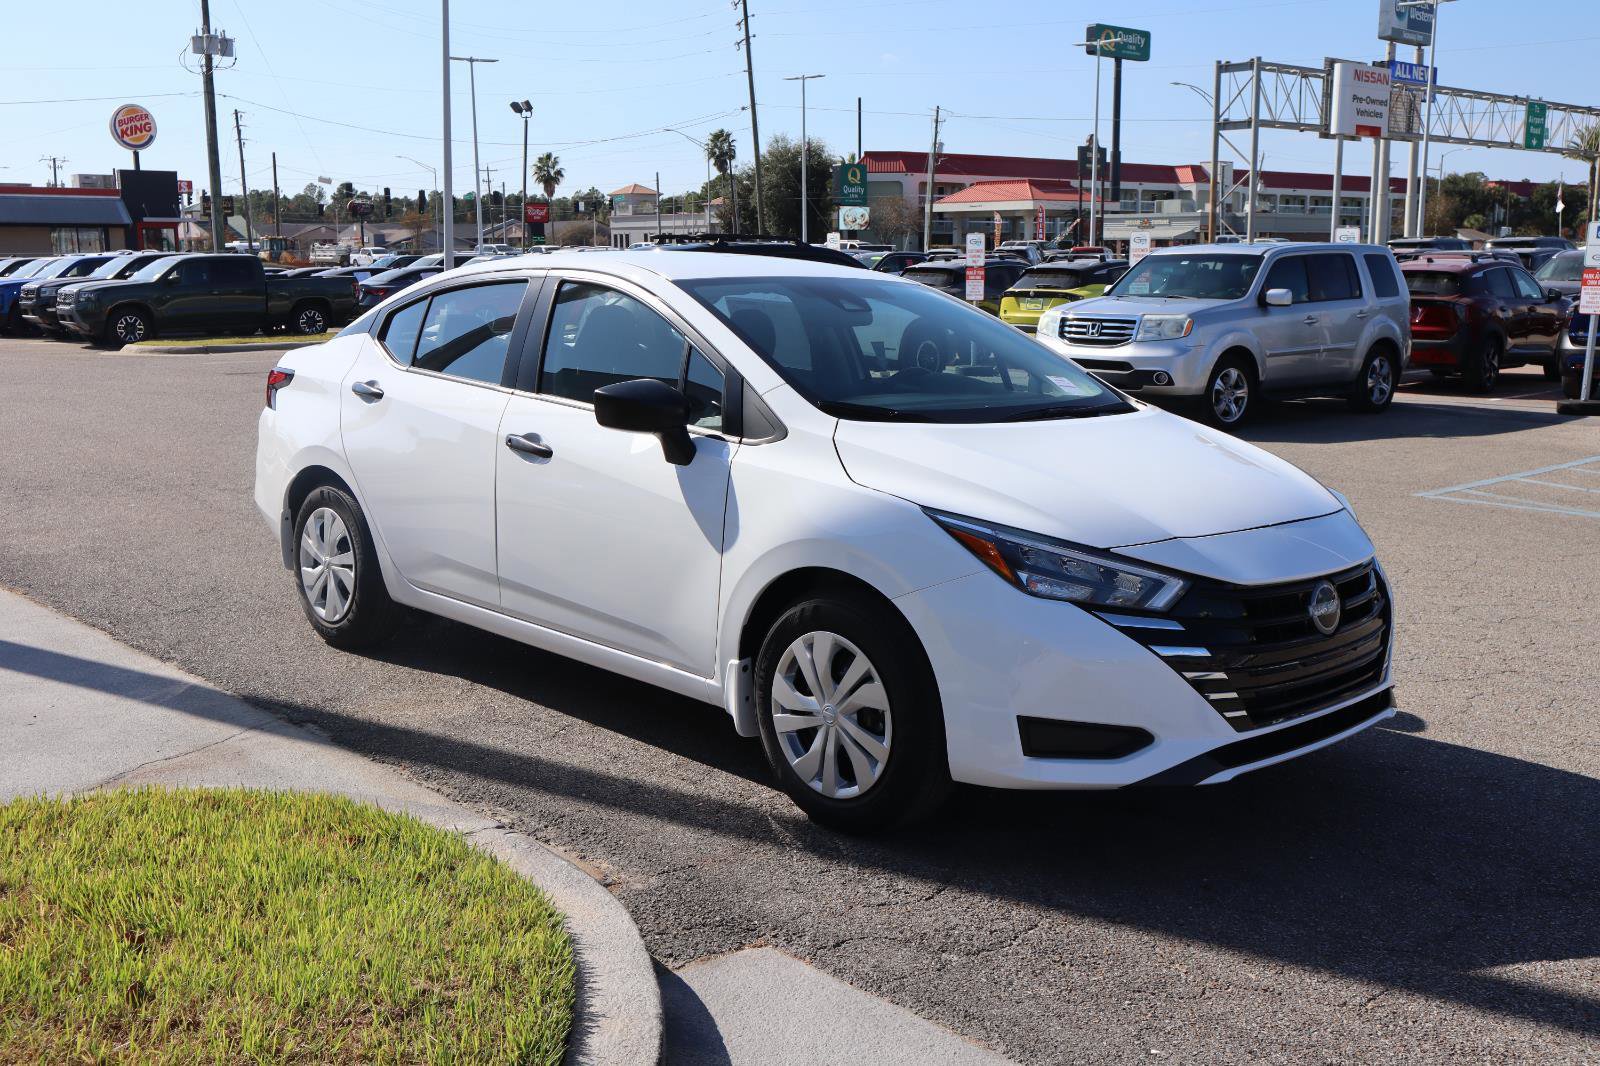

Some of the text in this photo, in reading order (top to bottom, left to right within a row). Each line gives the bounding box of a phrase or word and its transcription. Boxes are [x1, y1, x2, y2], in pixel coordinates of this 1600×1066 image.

[1410, 7, 1434, 22] Western
[1117, 31, 1145, 48] Quality
[1354, 69, 1390, 86] NISSAN
[1395, 64, 1411, 80] ALL
[1353, 94, 1389, 107] Pre-Owned
[118, 113, 150, 128] BURGER
[1356, 107, 1384, 119] Vehicles
[121, 121, 152, 139] KING
[843, 184, 865, 195] Quality
